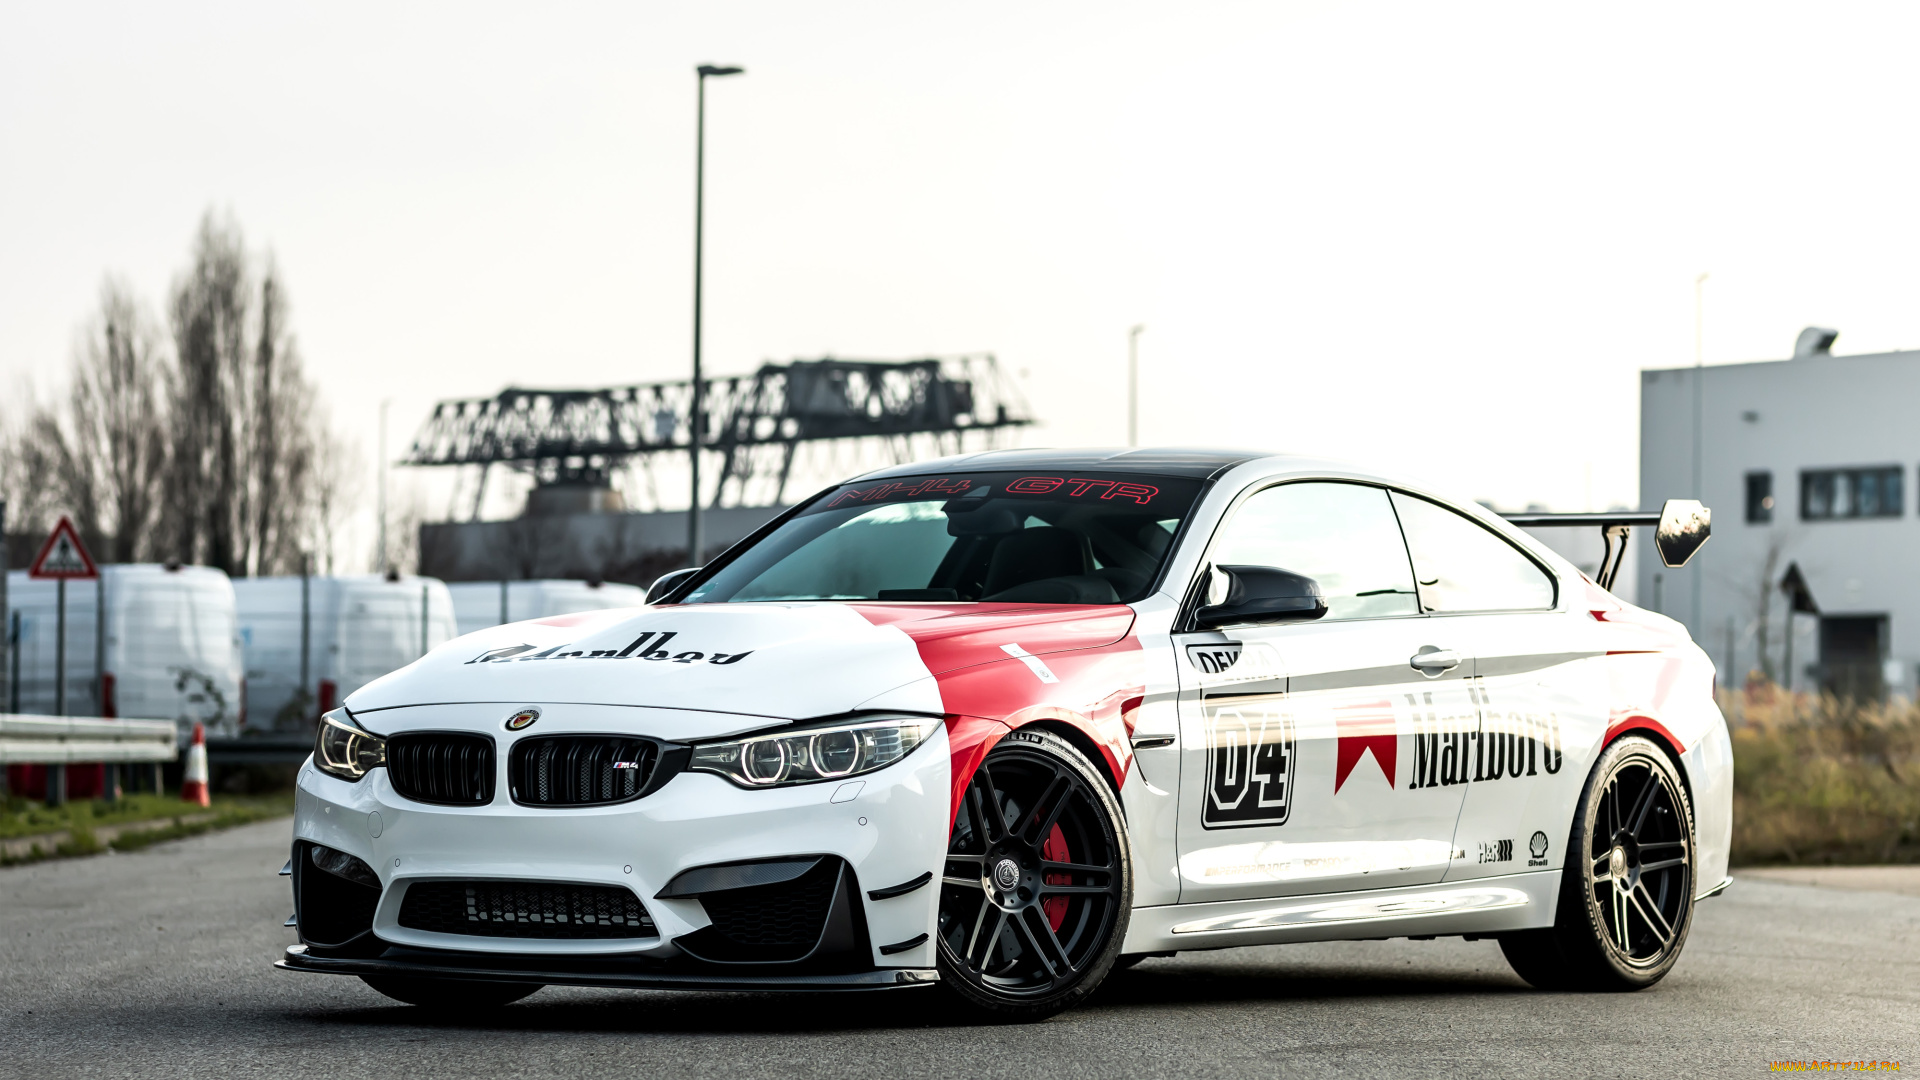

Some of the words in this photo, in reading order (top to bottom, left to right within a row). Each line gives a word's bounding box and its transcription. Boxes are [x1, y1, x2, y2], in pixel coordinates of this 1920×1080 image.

[1006, 477, 1158, 505] GTR
[1405, 675, 1562, 789] Marlboro
[618, 761, 638, 769] M4
[1210, 708, 1292, 810] 04
[1477, 840, 1504, 864] H&R
